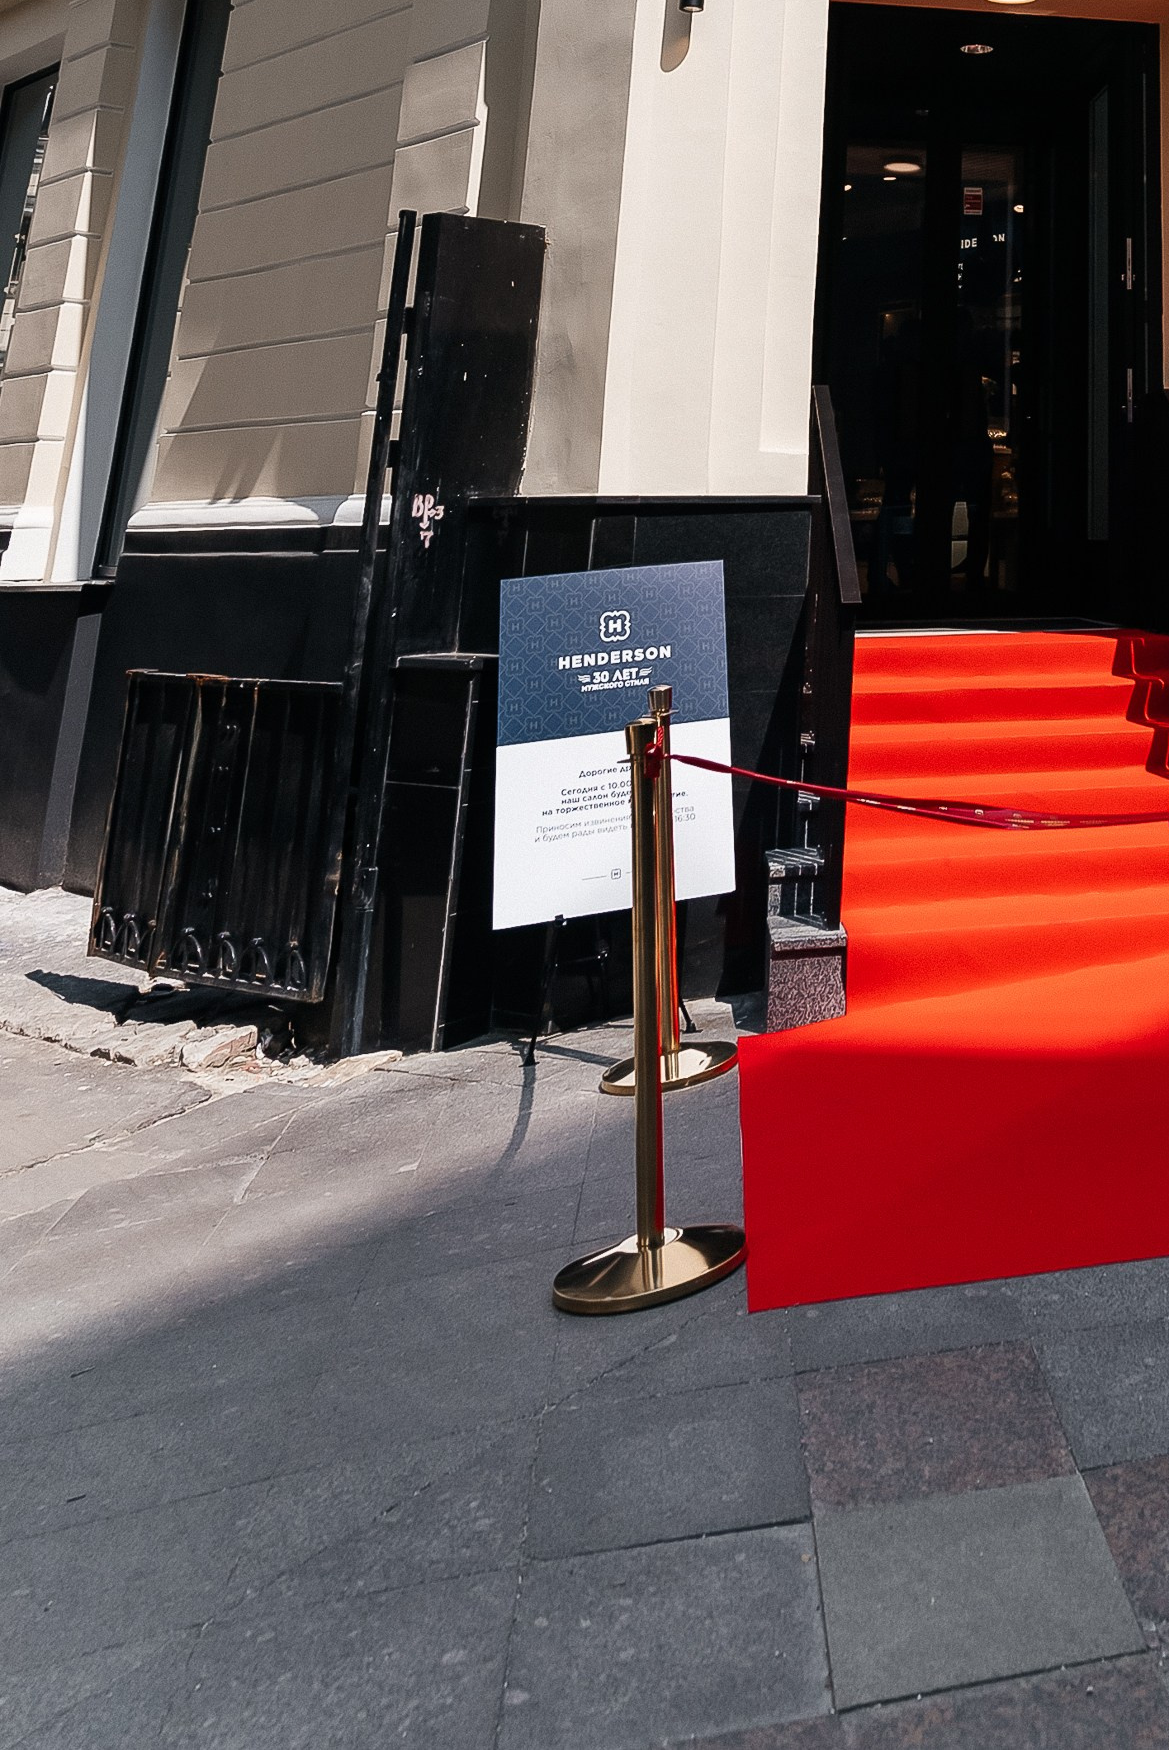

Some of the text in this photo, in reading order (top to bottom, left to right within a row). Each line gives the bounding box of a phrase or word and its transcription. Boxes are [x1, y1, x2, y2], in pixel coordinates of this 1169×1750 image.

[558, 645, 671, 670] HENDERSON
[592, 667, 639, 684] 30 ЛЕТ
[624, 678, 650, 687] СТИЛЯ
[578, 766, 618, 779] Дорогие
[561, 786, 599, 796] Сегодня
[561, 797, 580, 805] наш
[582, 793, 609, 802] салон
[555, 800, 626, 814] торжественное
[536, 822, 582, 833] Приносим
[542, 832, 570, 843] будем
[571, 829, 595, 839] рады
